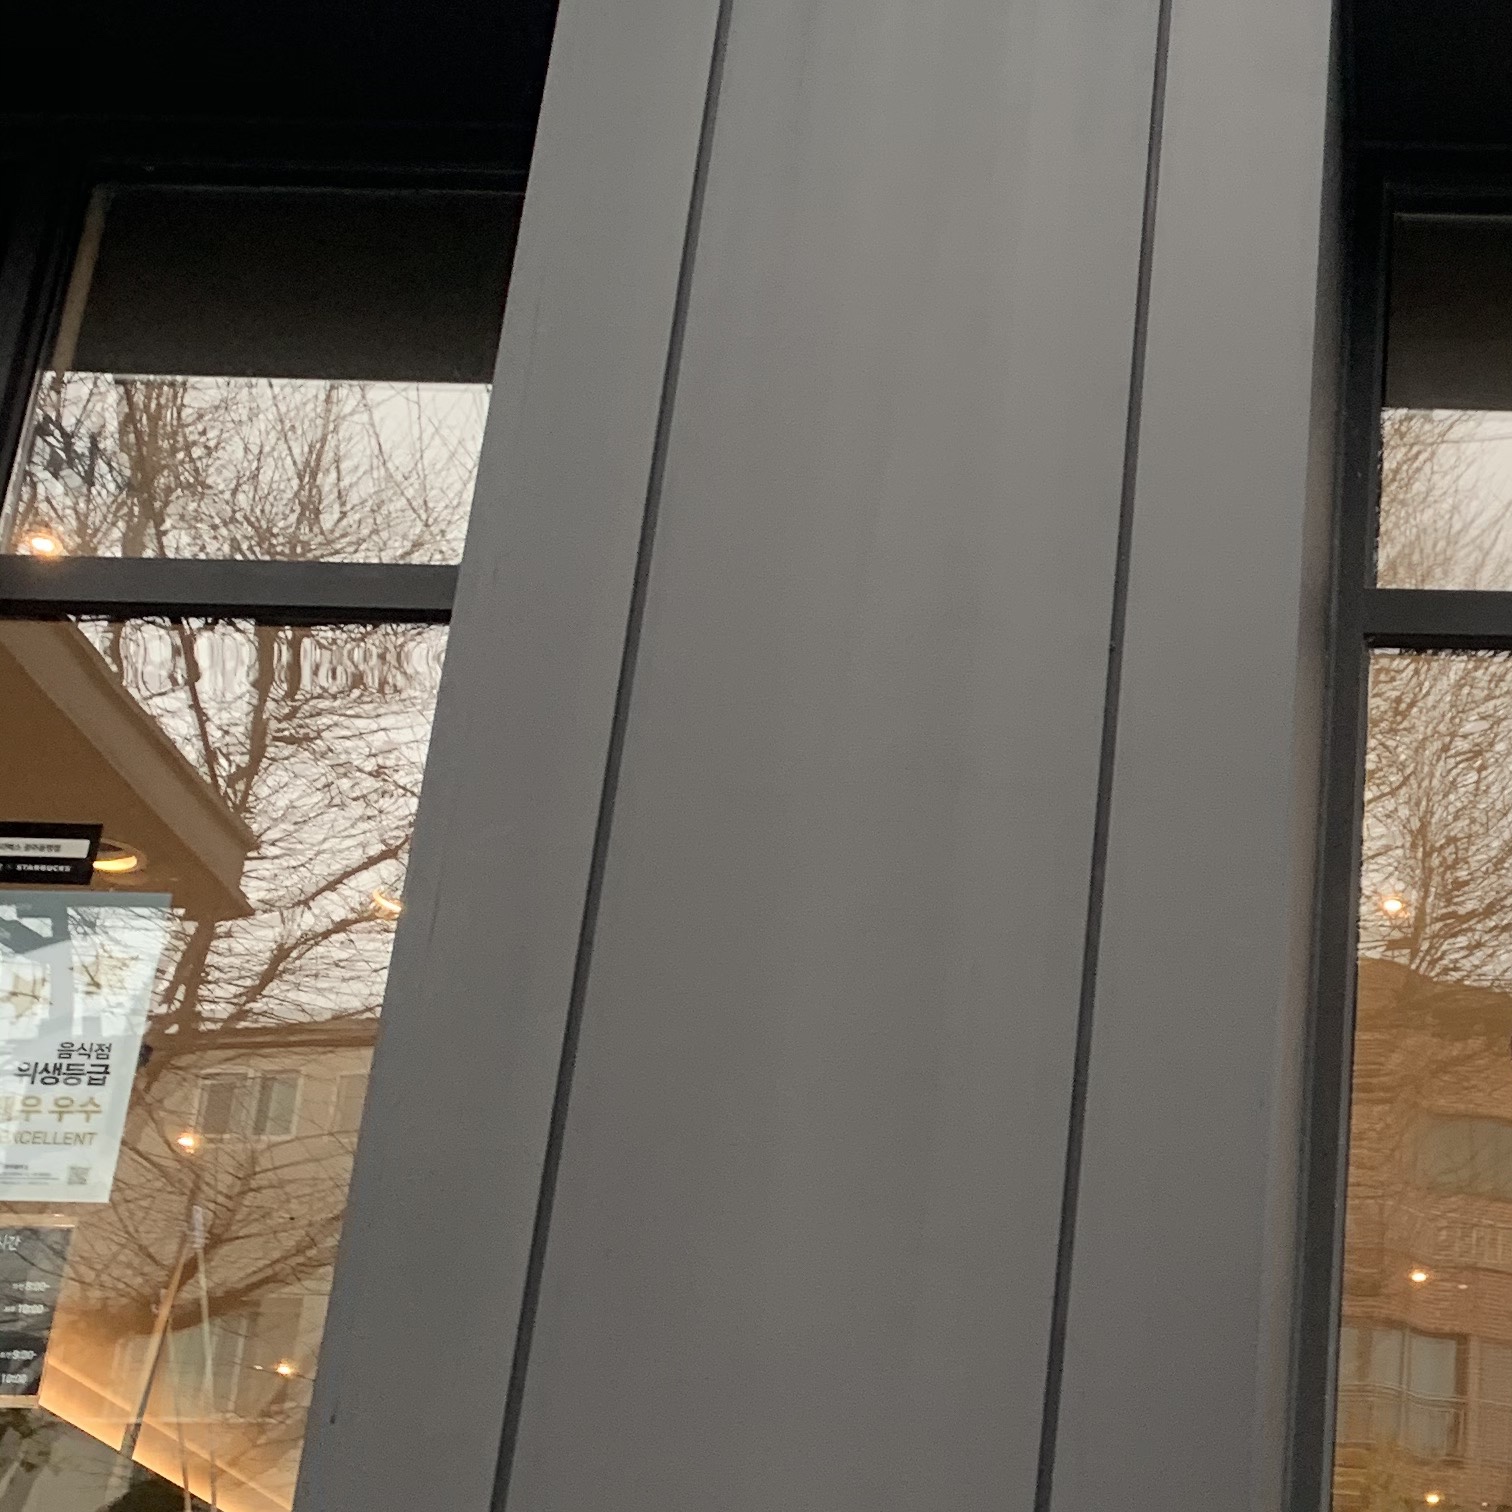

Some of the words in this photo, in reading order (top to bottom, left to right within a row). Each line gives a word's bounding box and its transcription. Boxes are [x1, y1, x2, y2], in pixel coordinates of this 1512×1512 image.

[16, 863, 71, 873] STARBUCKS
[57, 1041, 113, 1060] 음식점
[15, 1061, 111, 1087] 위생등급
[48, 1096, 102, 1123] 우수
